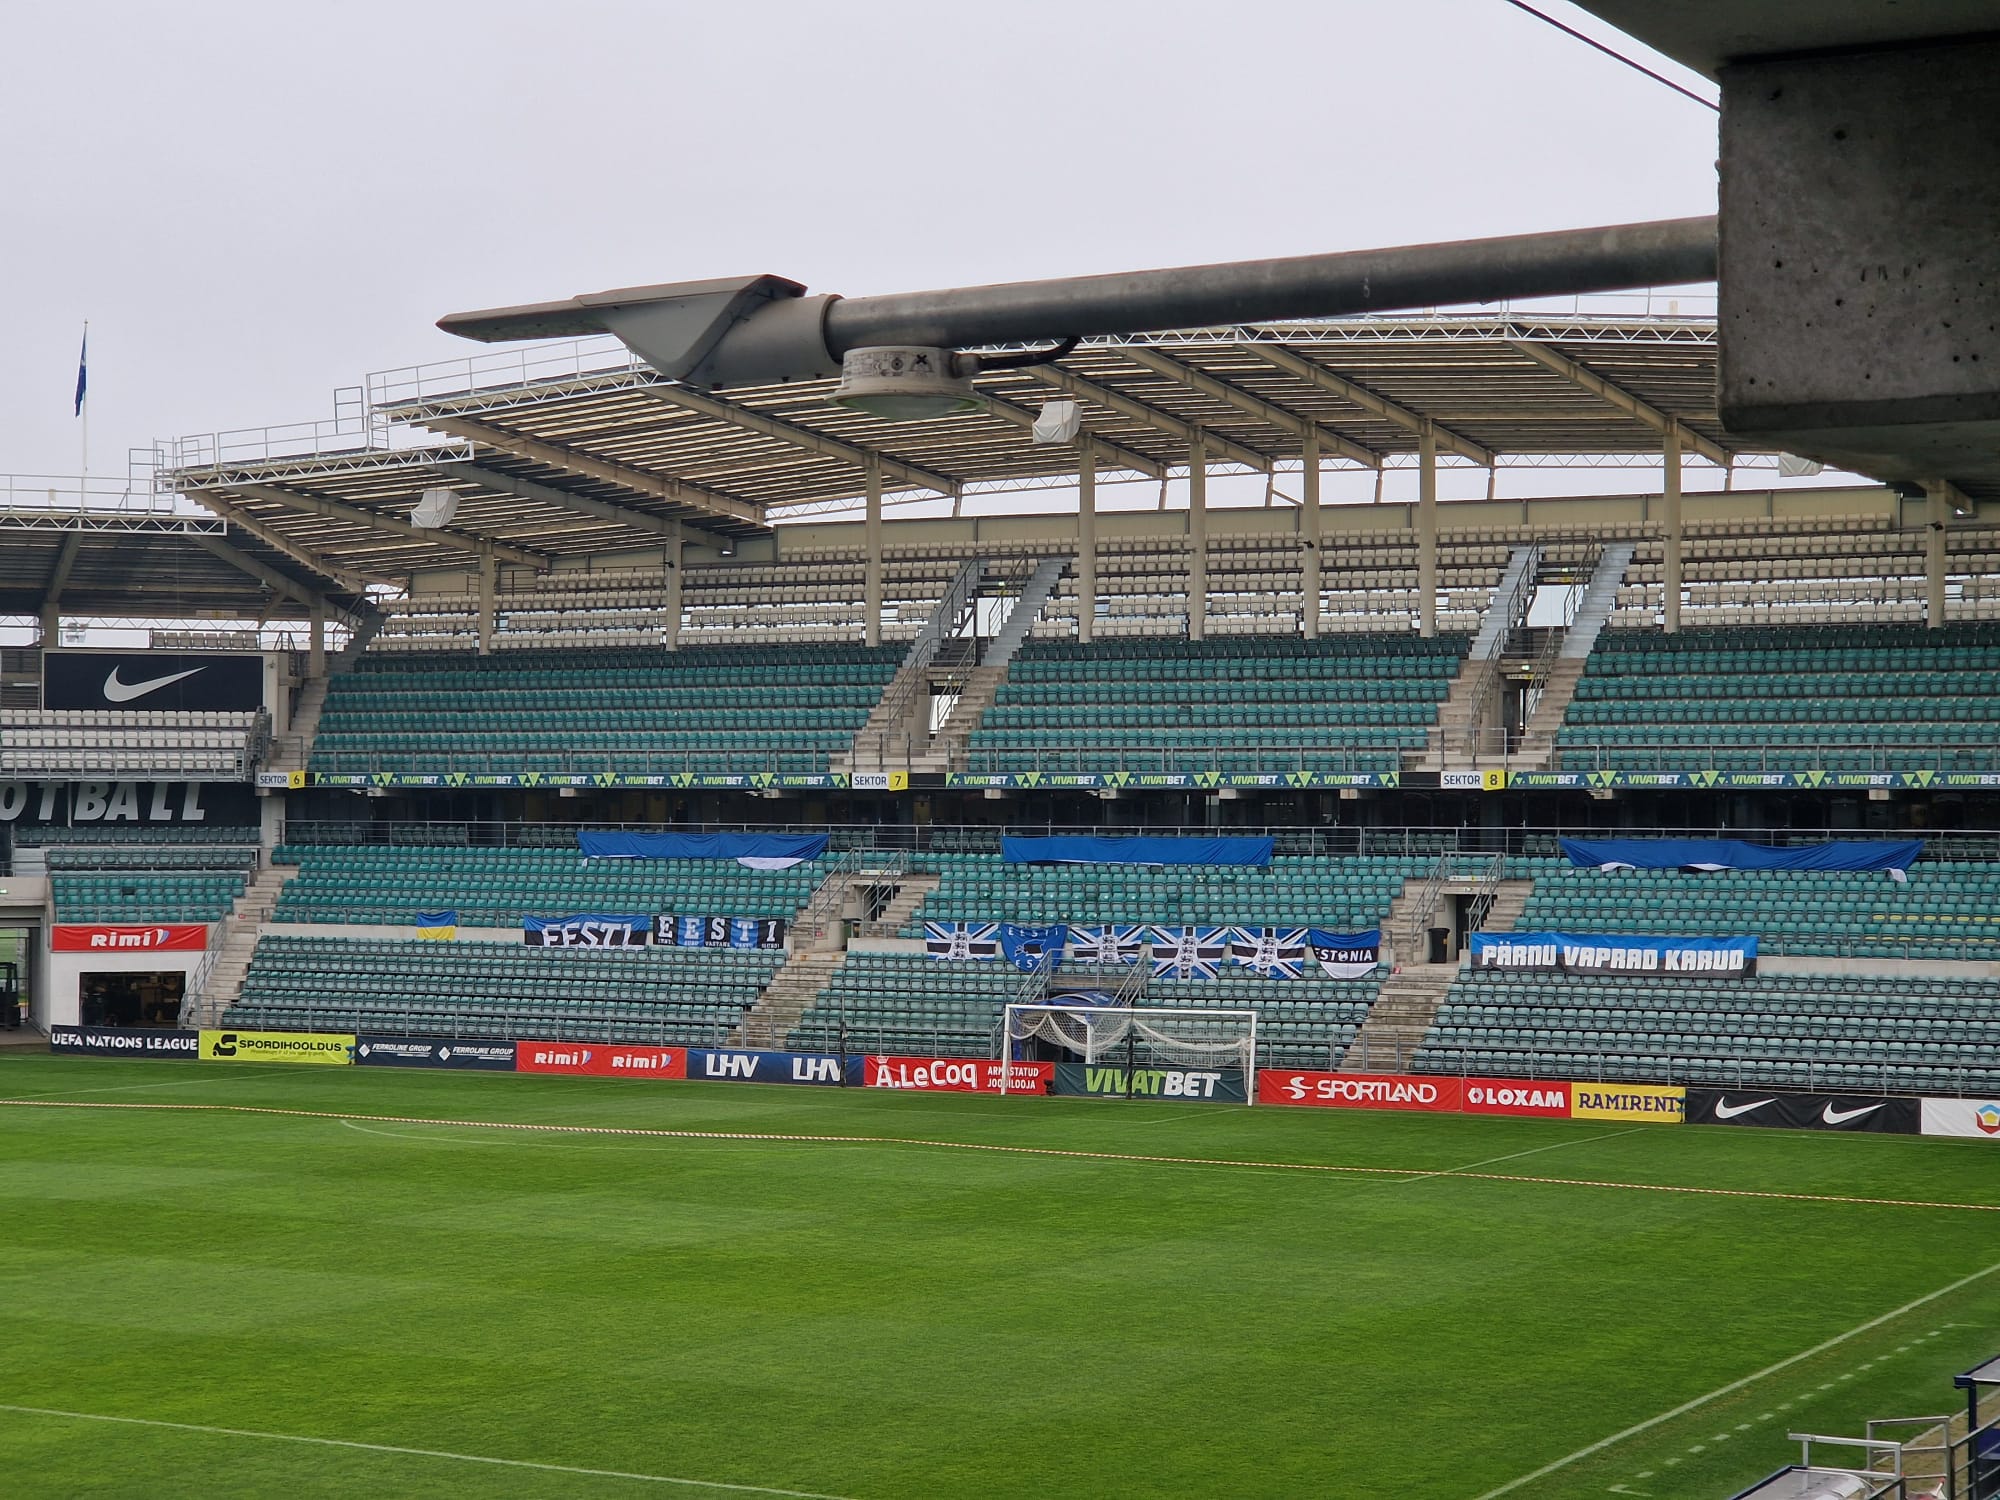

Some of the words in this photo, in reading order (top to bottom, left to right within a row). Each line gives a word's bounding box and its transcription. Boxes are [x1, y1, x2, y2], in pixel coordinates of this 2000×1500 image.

[259, 775, 288, 785] SEKTOR
[293, 775, 300, 785] 6
[330, 776, 366, 784] VIVATBET
[402, 776, 438, 784] VIVATBET
[475, 776, 511, 784] VIVATBET
[549, 776, 587, 784] VIVATBET
[625, 776, 665, 784] VIVATBET
[703, 776, 743, 784] VIVATBET
[783, 776, 824, 784] VIVATBET
[854, 776, 887, 786] SEKTOR
[894, 776, 902, 787] 7
[964, 776, 1007, 785] VIVATBET
[1051, 776, 1096, 785] VIVATBET
[1141, 776, 1187, 785] VIVATBET
[1231, 776, 1277, 785] VIVATBET
[1324, 776, 1370, 785] VIVATBET
[1443, 774, 1481, 786] SEKTOR
[1489, 774, 1498, 787] 8
[1528, 775, 1578, 785] VIVATBET
[1628, 775, 1680, 785] VIVATBET
[1733, 775, 1785, 785] VIVATBET
[1838, 775, 1893, 785] VIVATBET
[658, 916, 777, 942] EESTI
[1008, 927, 1058, 937] EESTI
[91, 932, 151, 948] Rimi
[1482, 941, 1557, 966] PÄRNU
[1564, 945, 1661, 970] VAPRAD
[1665, 950, 1744, 971] KARUD
[52, 1033, 82, 1047] UEFA
[86, 1034, 142, 1050] NATIONS
[146, 1036, 198, 1051] LEAGUE
[239, 1039, 342, 1052] SPORDIHOOLDUS
[372, 1043, 408, 1051] FERROLINE
[408, 1044, 432, 1052] GROUP
[453, 1046, 489, 1054] FERROLINE
[489, 1047, 514, 1055] GROUP
[534, 1050, 578, 1066] Rimi
[612, 1053, 657, 1070] Rimi
[706, 1053, 759, 1078] LHV
[987, 1078, 1036, 1089] JOOILOOJA
[1085, 1068, 1221, 1098] VIVATBET
[1317, 1079, 1438, 1104] SPORTLAND
[1486, 1088, 1565, 1108] LOXAM
[1578, 1093, 1678, 1112] RAMIRENT
